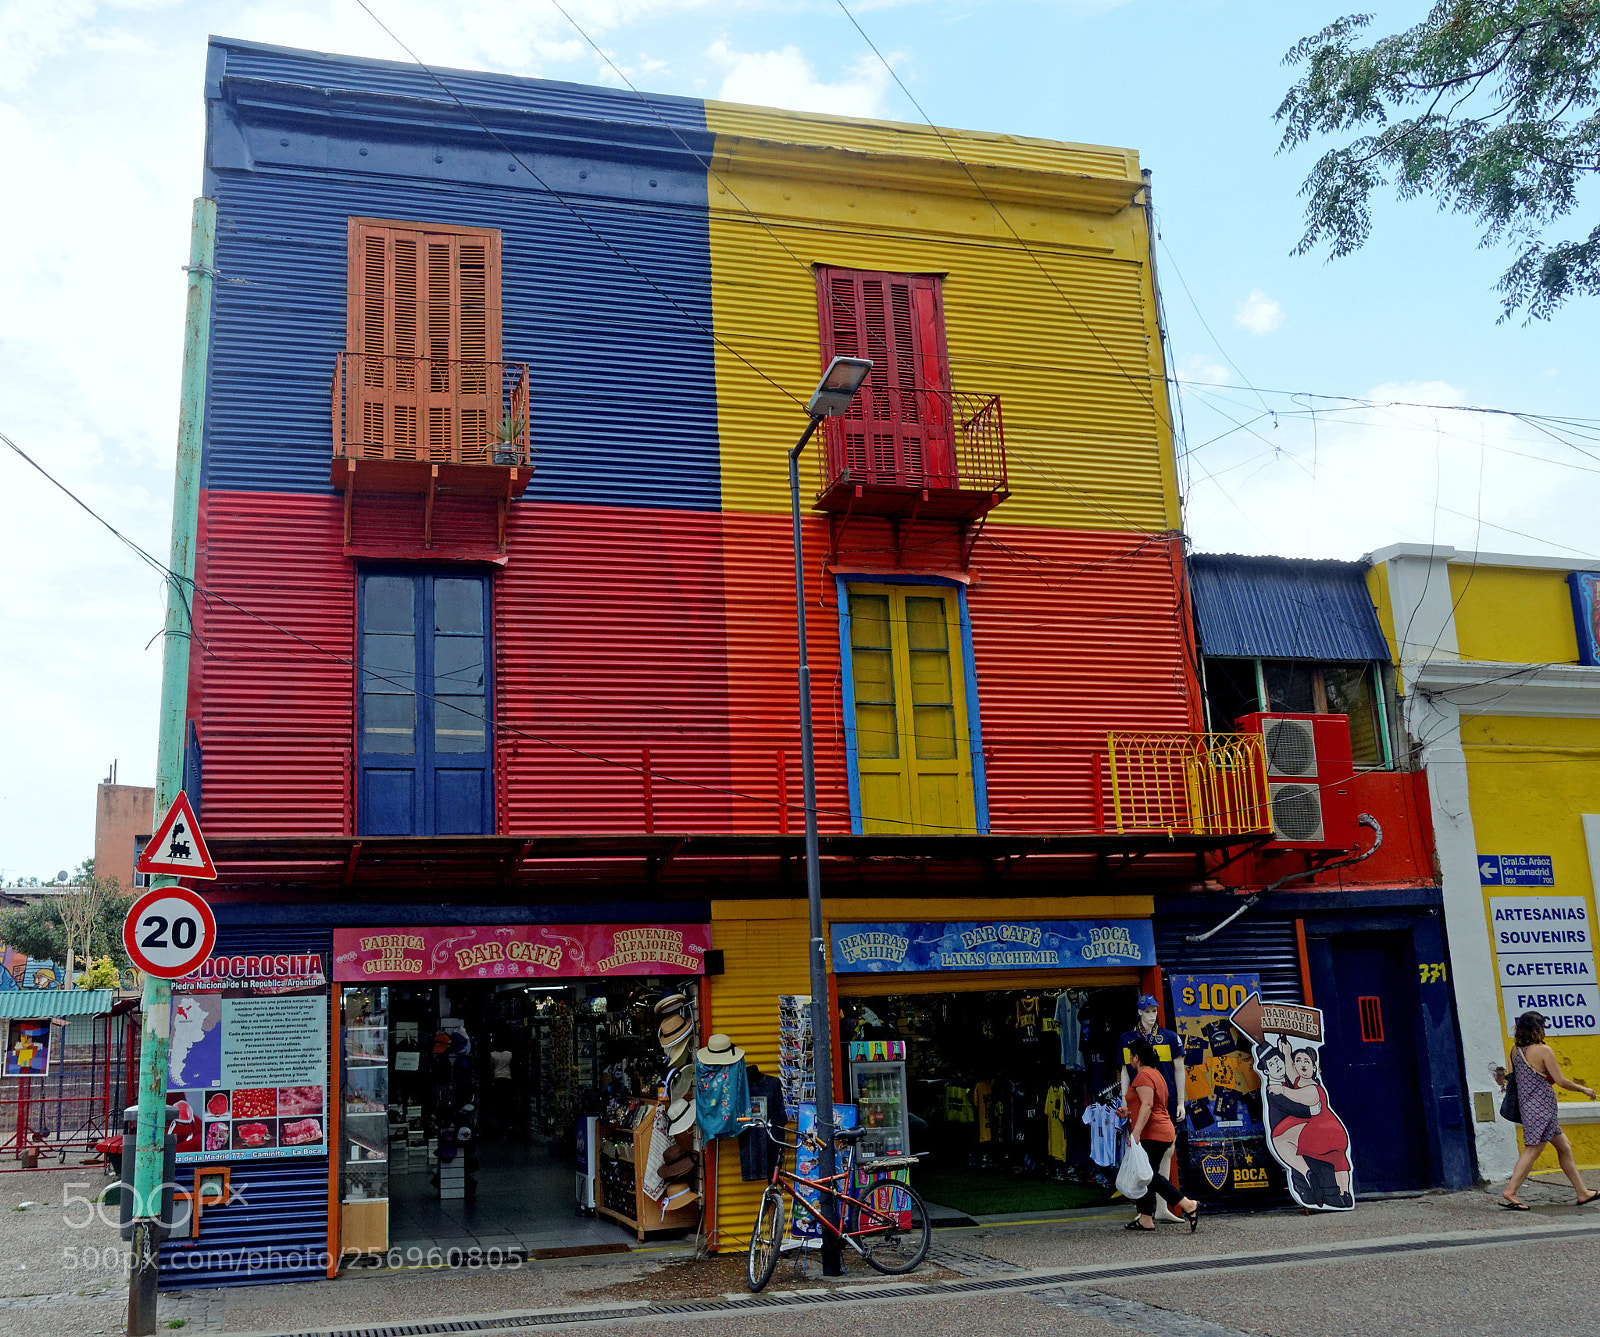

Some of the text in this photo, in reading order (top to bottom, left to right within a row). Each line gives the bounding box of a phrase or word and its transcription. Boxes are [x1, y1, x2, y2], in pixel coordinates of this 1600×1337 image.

[1529, 857, 1550, 866] Aráoz
[1504, 867, 1549, 876] de Lamadrid
[1495, 907, 1585, 921] ARTESANIAS
[141, 916, 198, 950] 20
[614, 928, 683, 944] SOUVENIRS
[960, 925, 1041, 949] BAR CAFÉ
[1089, 927, 1130, 942] BOCA
[1500, 930, 1586, 944] SOUVENIRS
[360, 935, 425, 952] FABRICA
[614, 940, 683, 955] ALFAJORES
[839, 932, 908, 952] REMERAS
[381, 947, 404, 960] DE
[456, 941, 563, 970] BAR CAFÉ
[844, 945, 906, 964] T-SHIRT
[941, 950, 1059, 967] LANAS CACHEMIR
[1081, 941, 1141, 961] OFICIAL
[363, 958, 423, 974] CUEROS
[597, 951, 699, 972] DULCE DE LECHE
[1506, 962, 1589, 976] CAFETERIA
[1419, 962, 1446, 983] 771
[171, 982, 194, 990] Piedra
[196, 981, 229, 989] Nacional
[241, 980, 248, 988] la
[250, 979, 286, 989] República
[287, 978, 322, 988] Argentina
[1182, 983, 1247, 1010] $100
[1518, 993, 1587, 1008] FABRICA
[1264, 1007, 1286, 1019] BAR
[1261, 1017, 1319, 1035] ALFAJORES
[1544, 1014, 1596, 1029] CUERO
[252, 1150, 285, 1158] Caminito
[1206, 1166, 1225, 1174] CABJ
[1233, 1168, 1268, 1181] BOCA
